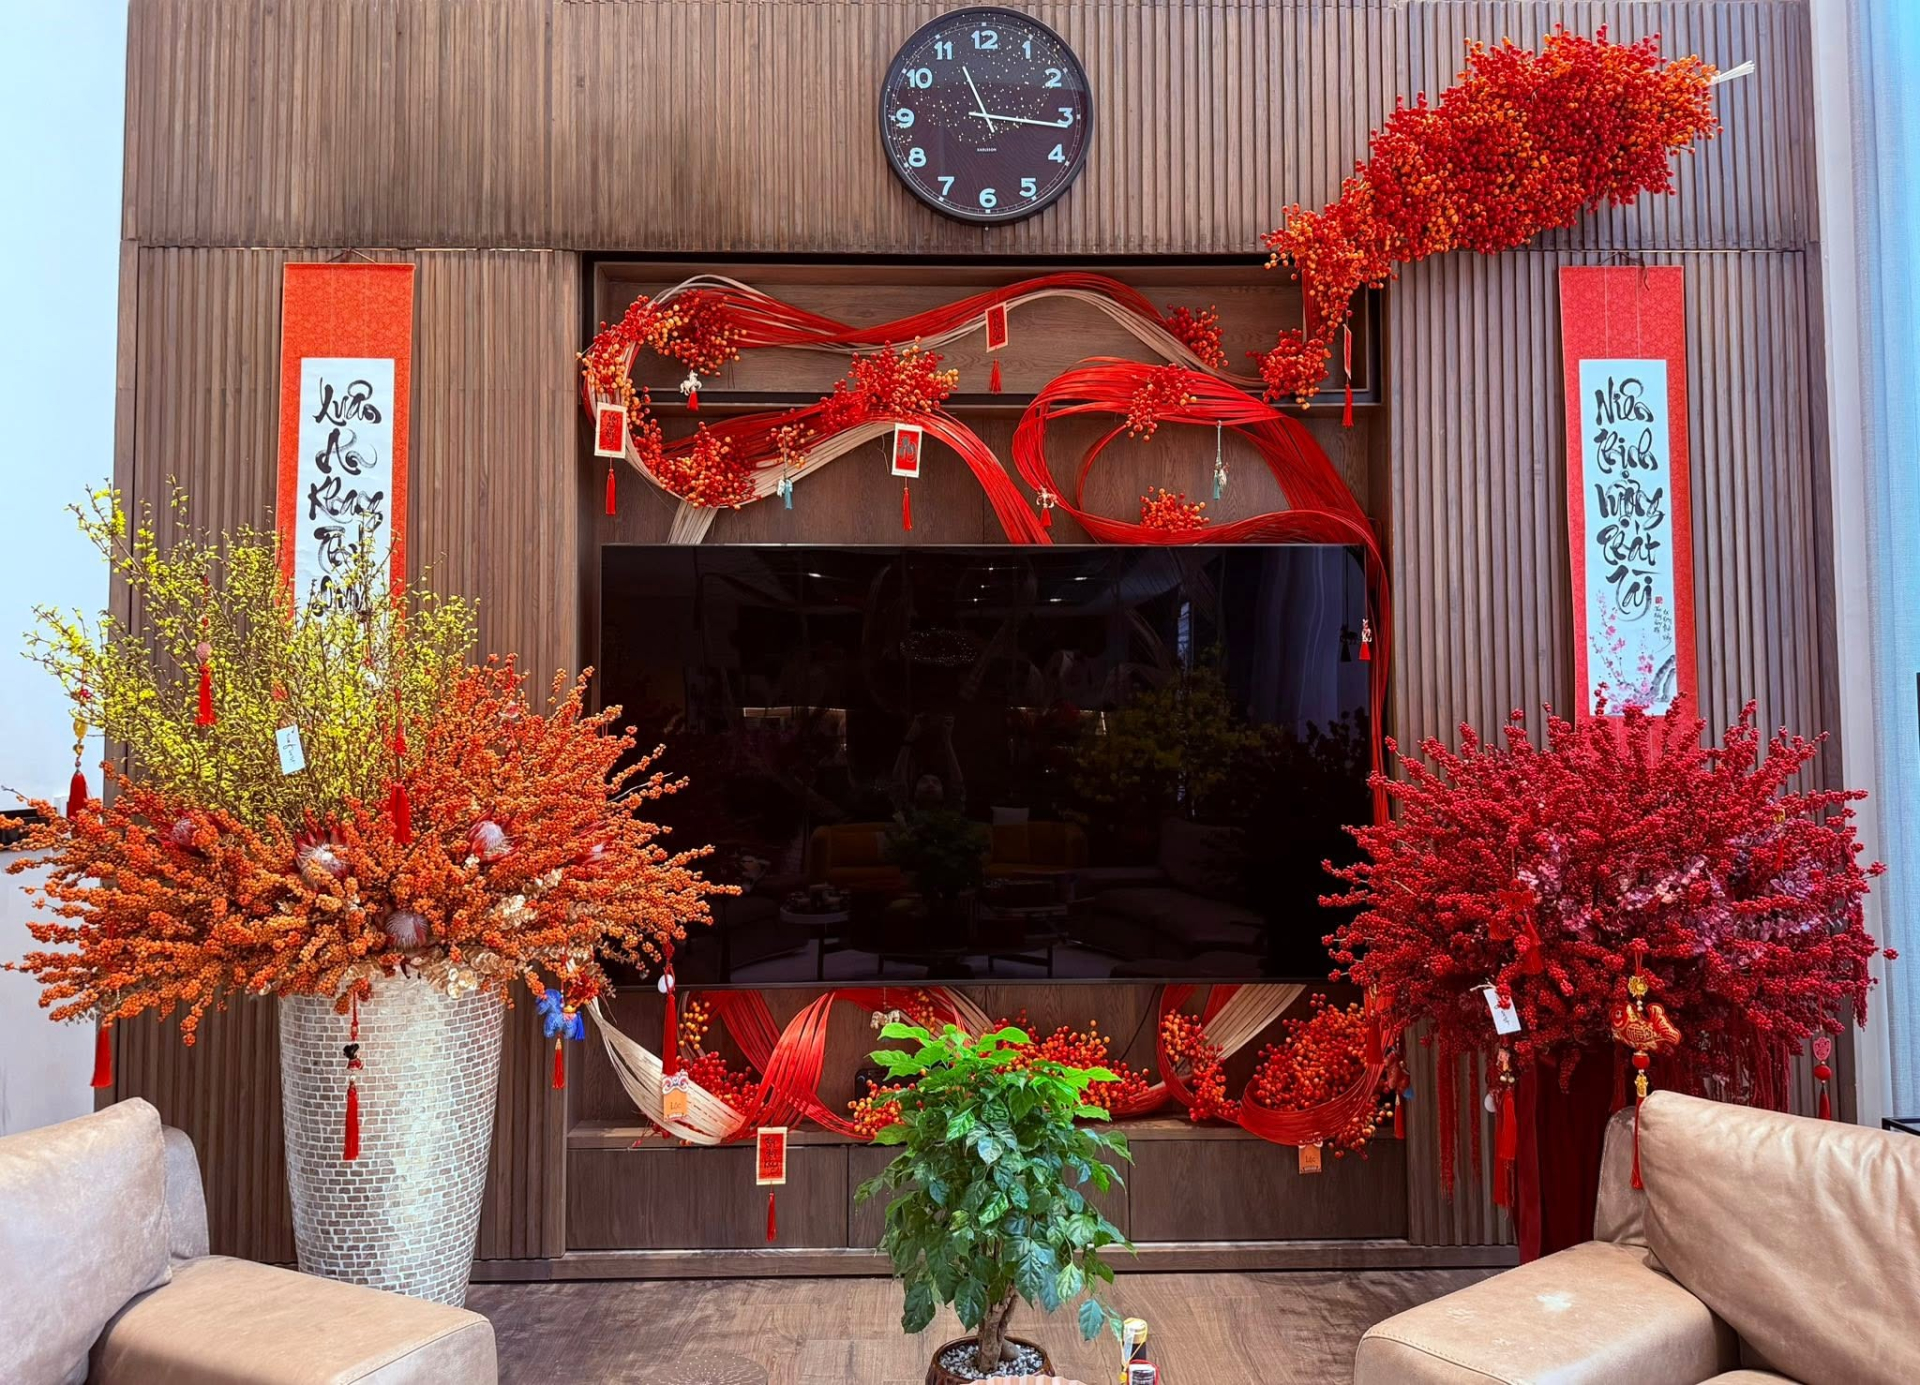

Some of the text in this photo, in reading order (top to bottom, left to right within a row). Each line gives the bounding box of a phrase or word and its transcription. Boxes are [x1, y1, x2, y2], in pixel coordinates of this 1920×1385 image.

[971, 30, 998, 49] 12
[934, 41, 952, 60] 11
[1022, 41, 1031, 59] 1
[906, 68, 932, 89] 10
[1045, 68, 1061, 87] 2
[896, 108, 914, 128] 9
[1057, 108, 1073, 127] 3
[908, 148, 926, 167] 8
[1048, 144, 1065, 163] 4
[938, 177, 954, 195] 7
[1020, 178, 1036, 196] 5
[979, 188, 996, 208] 6
